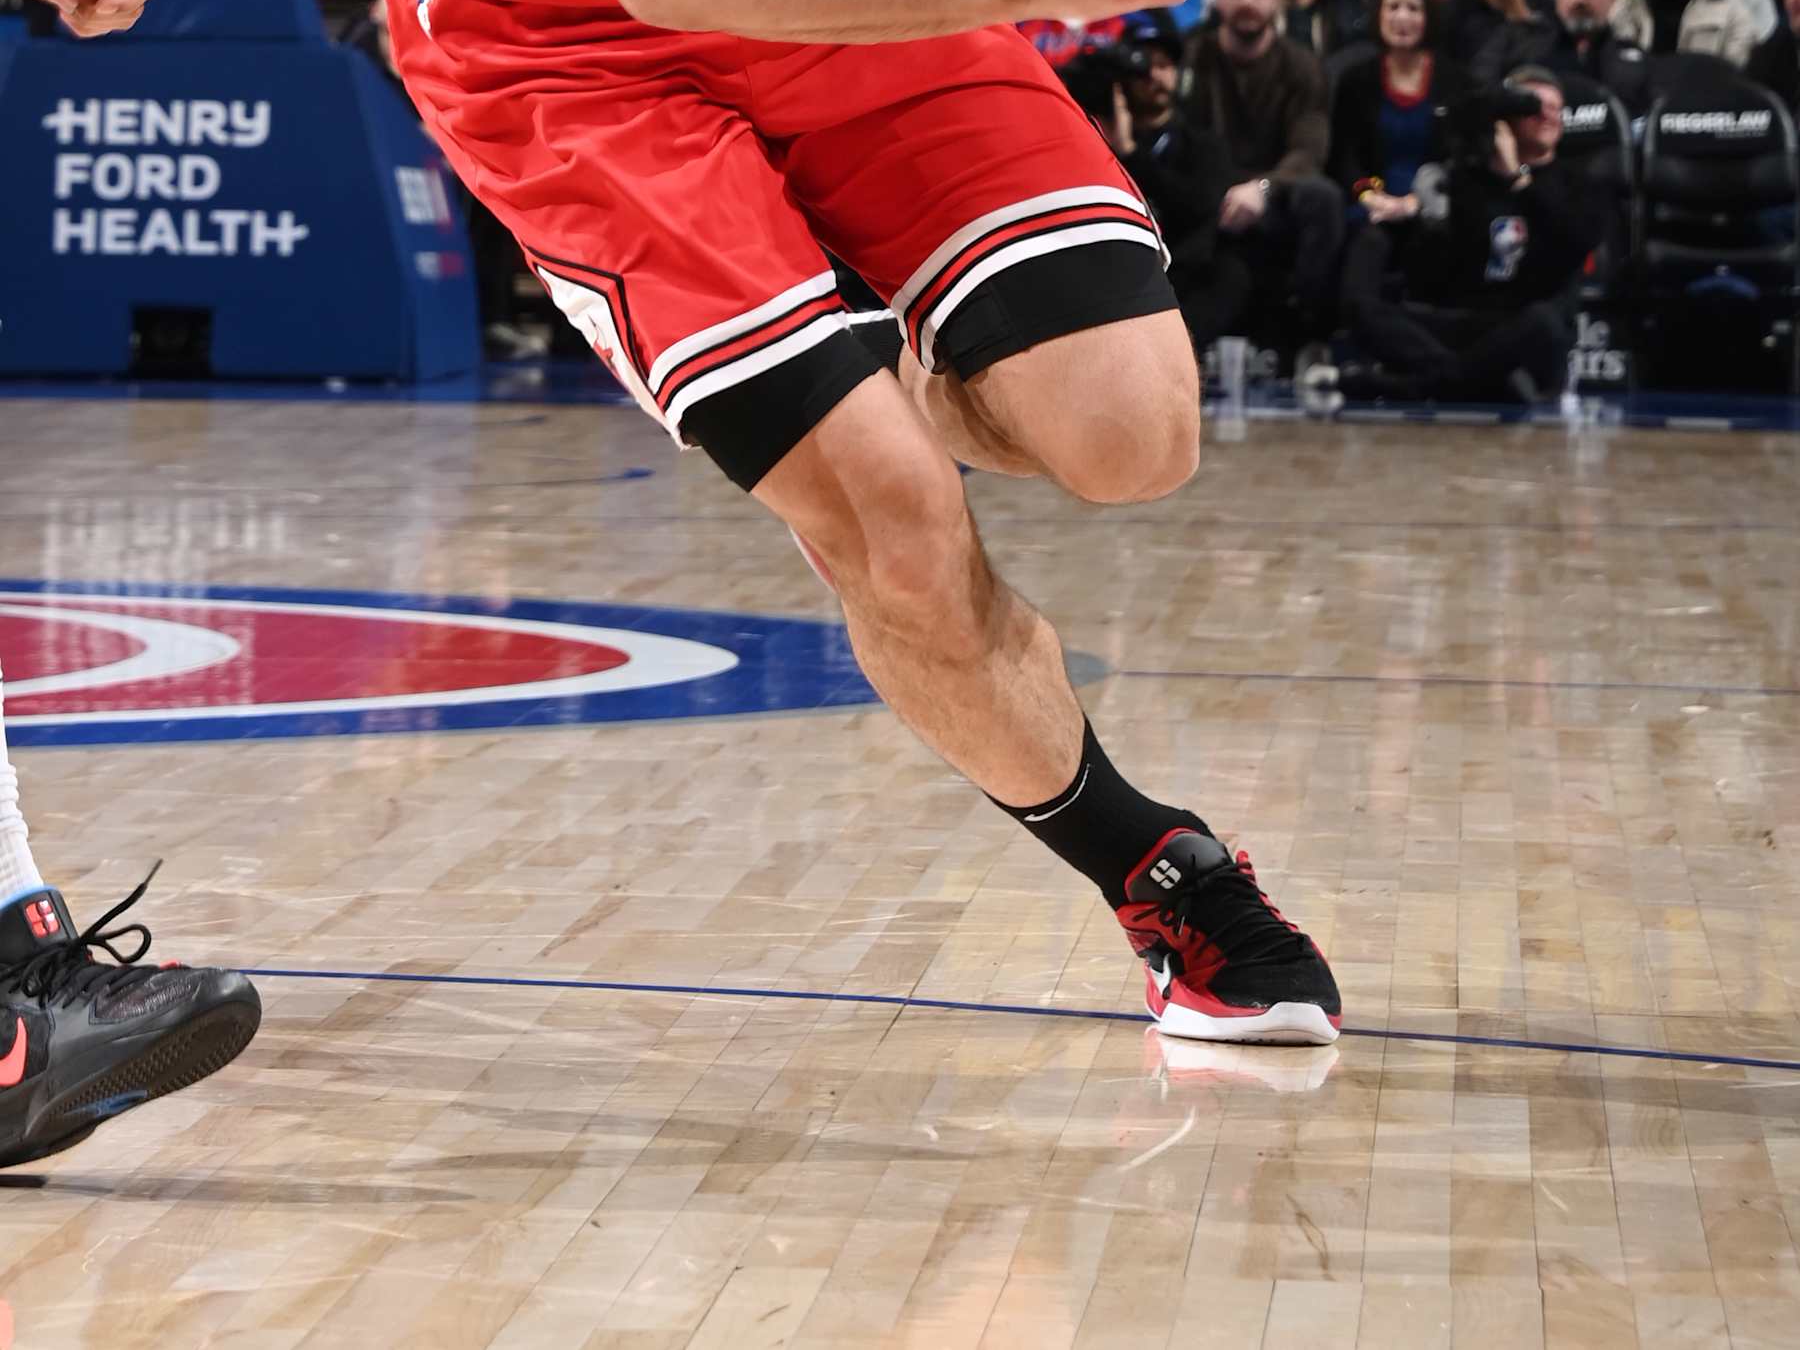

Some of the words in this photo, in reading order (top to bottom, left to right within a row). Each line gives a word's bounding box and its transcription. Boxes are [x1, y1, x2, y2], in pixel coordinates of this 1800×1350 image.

[43, 98, 271, 147] HENRY
[54, 153, 221, 201] FORD
[52, 209, 310, 257] HEALTH
